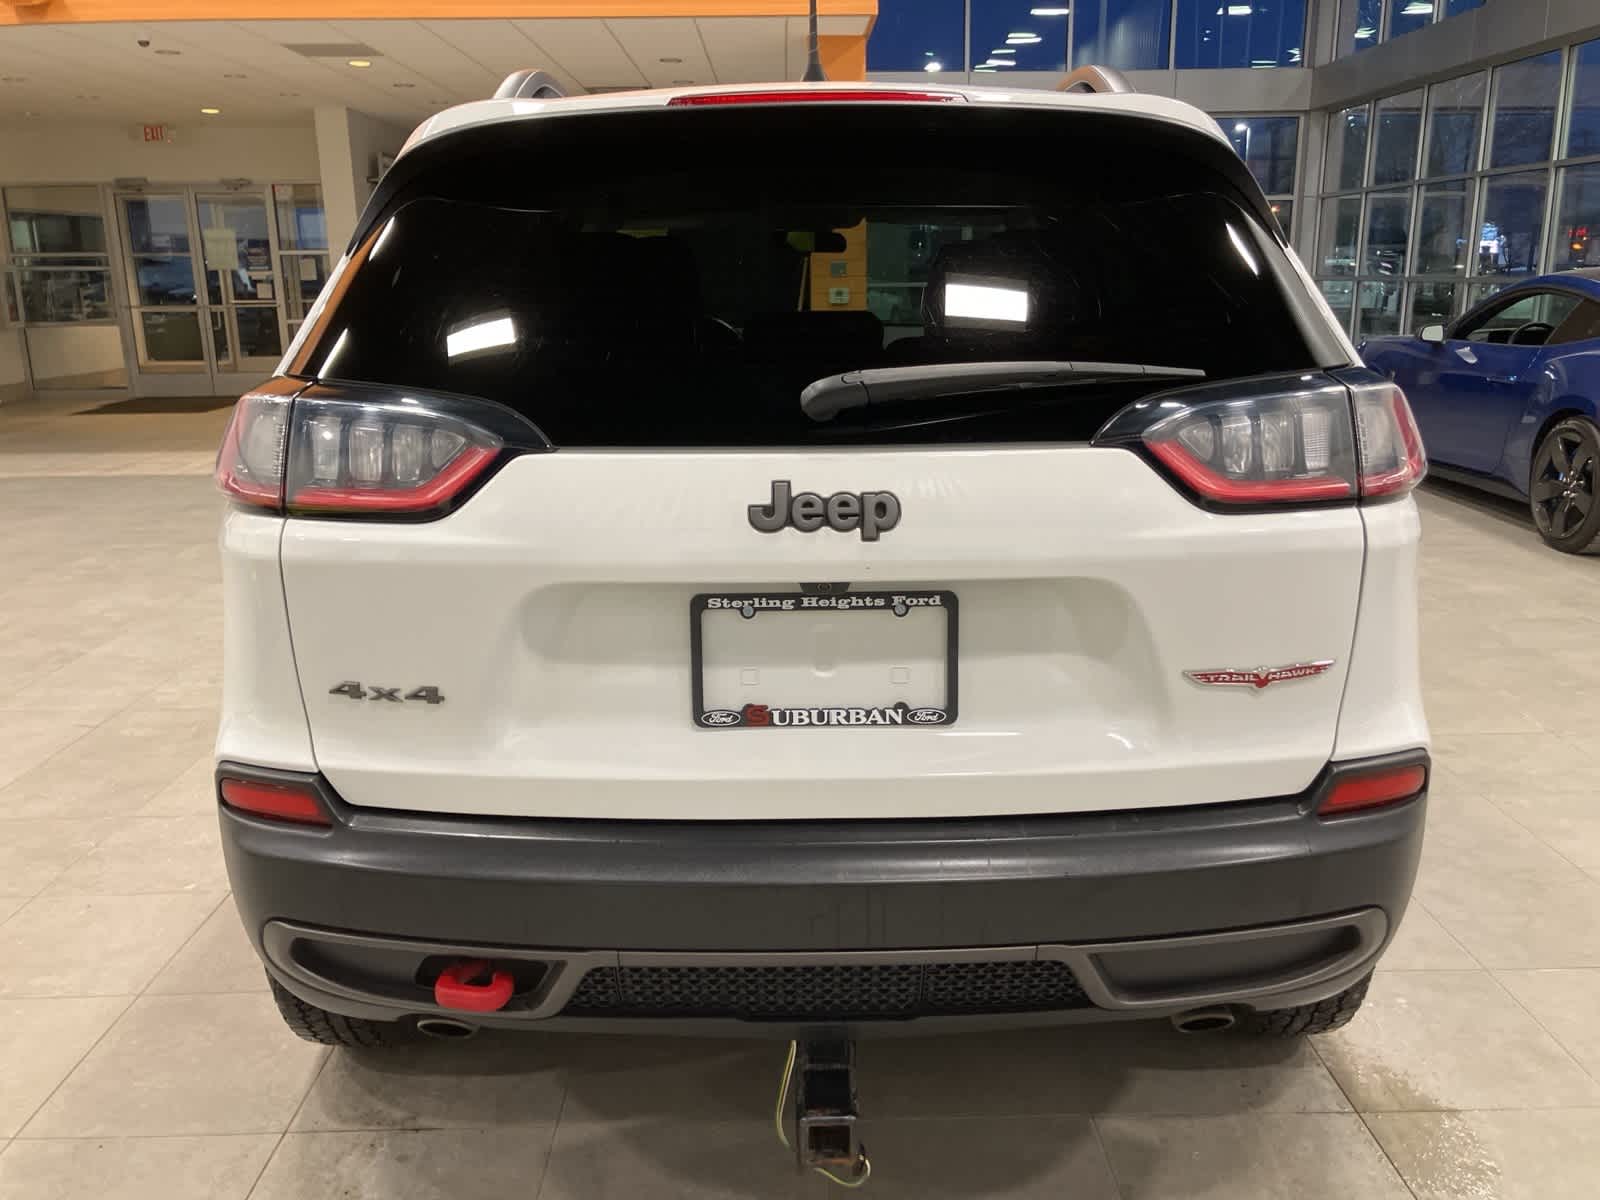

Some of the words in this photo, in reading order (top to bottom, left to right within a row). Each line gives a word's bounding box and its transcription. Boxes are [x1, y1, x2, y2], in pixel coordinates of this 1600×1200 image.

[747, 480, 902, 542] Jeep
[707, 597, 796, 610] Sterling
[801, 596, 886, 609] Heights
[891, 594, 943, 606] Ford
[745, 704, 903, 727] SUBURBAN
